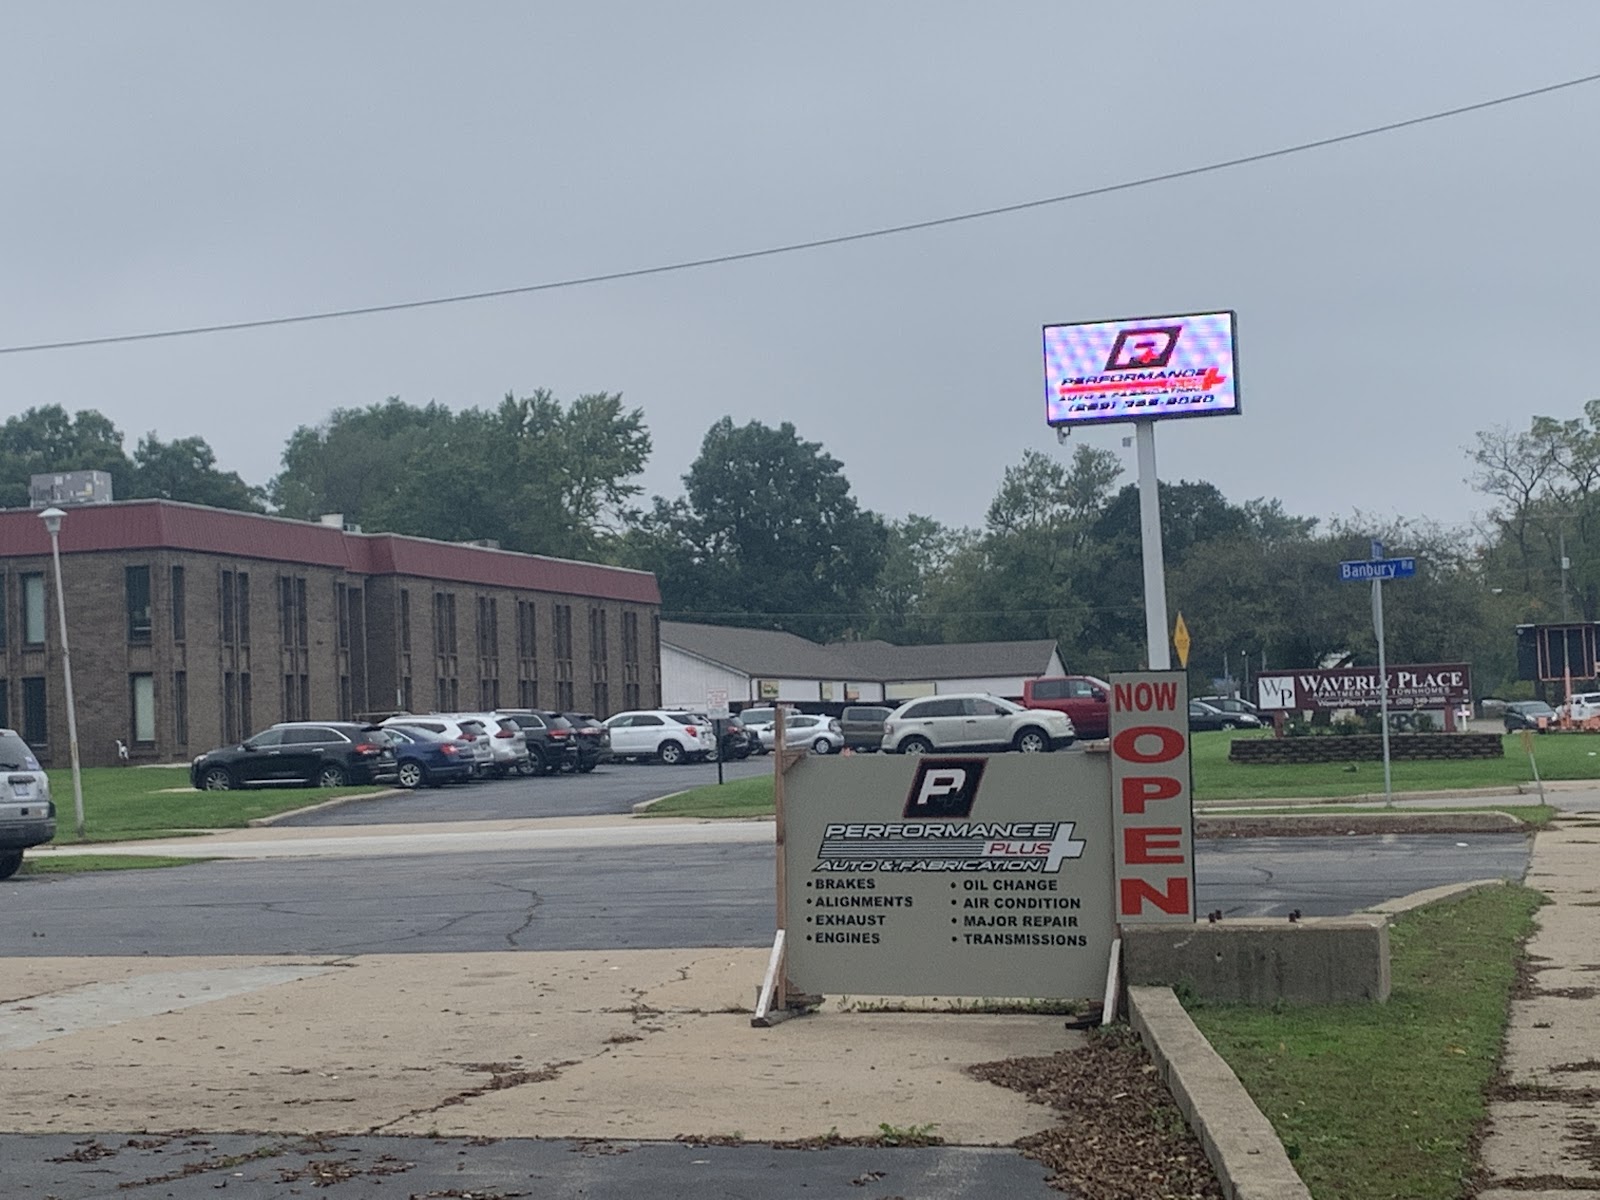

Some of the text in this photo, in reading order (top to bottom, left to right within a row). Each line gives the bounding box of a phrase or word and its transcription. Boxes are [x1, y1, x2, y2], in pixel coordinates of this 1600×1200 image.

[1062, 368, 1208, 385] PERFORMANCE
[1342, 564, 1396, 578] Banbury
[1299, 672, 1463, 692] WAVERLY PLACE
[1114, 682, 1177, 712] NOW
[1313, 690, 1366, 698] APARTMENT
[1392, 687, 1450, 695] TOWNHOMES
[1113, 726, 1190, 915] OPEN
[825, 823, 1054, 838] PERFORMANCE
[989, 842, 1052, 855] PLUS
[814, 860, 877, 871] AUTO
[899, 860, 1041, 872] FABRICATION
[815, 878, 876, 889] BRAKES
[963, 880, 1058, 891] OIL CHANGE
[815, 896, 913, 907] ALIGNMENTS
[963, 898, 1081, 909] AIR CONDITION
[815, 914, 886, 926] EXHAUST
[964, 916, 1079, 928] MAJOR REPAIR
[815, 933, 880, 944] ENGINES
[963, 934, 1087, 946] TRANSMISSIONS
